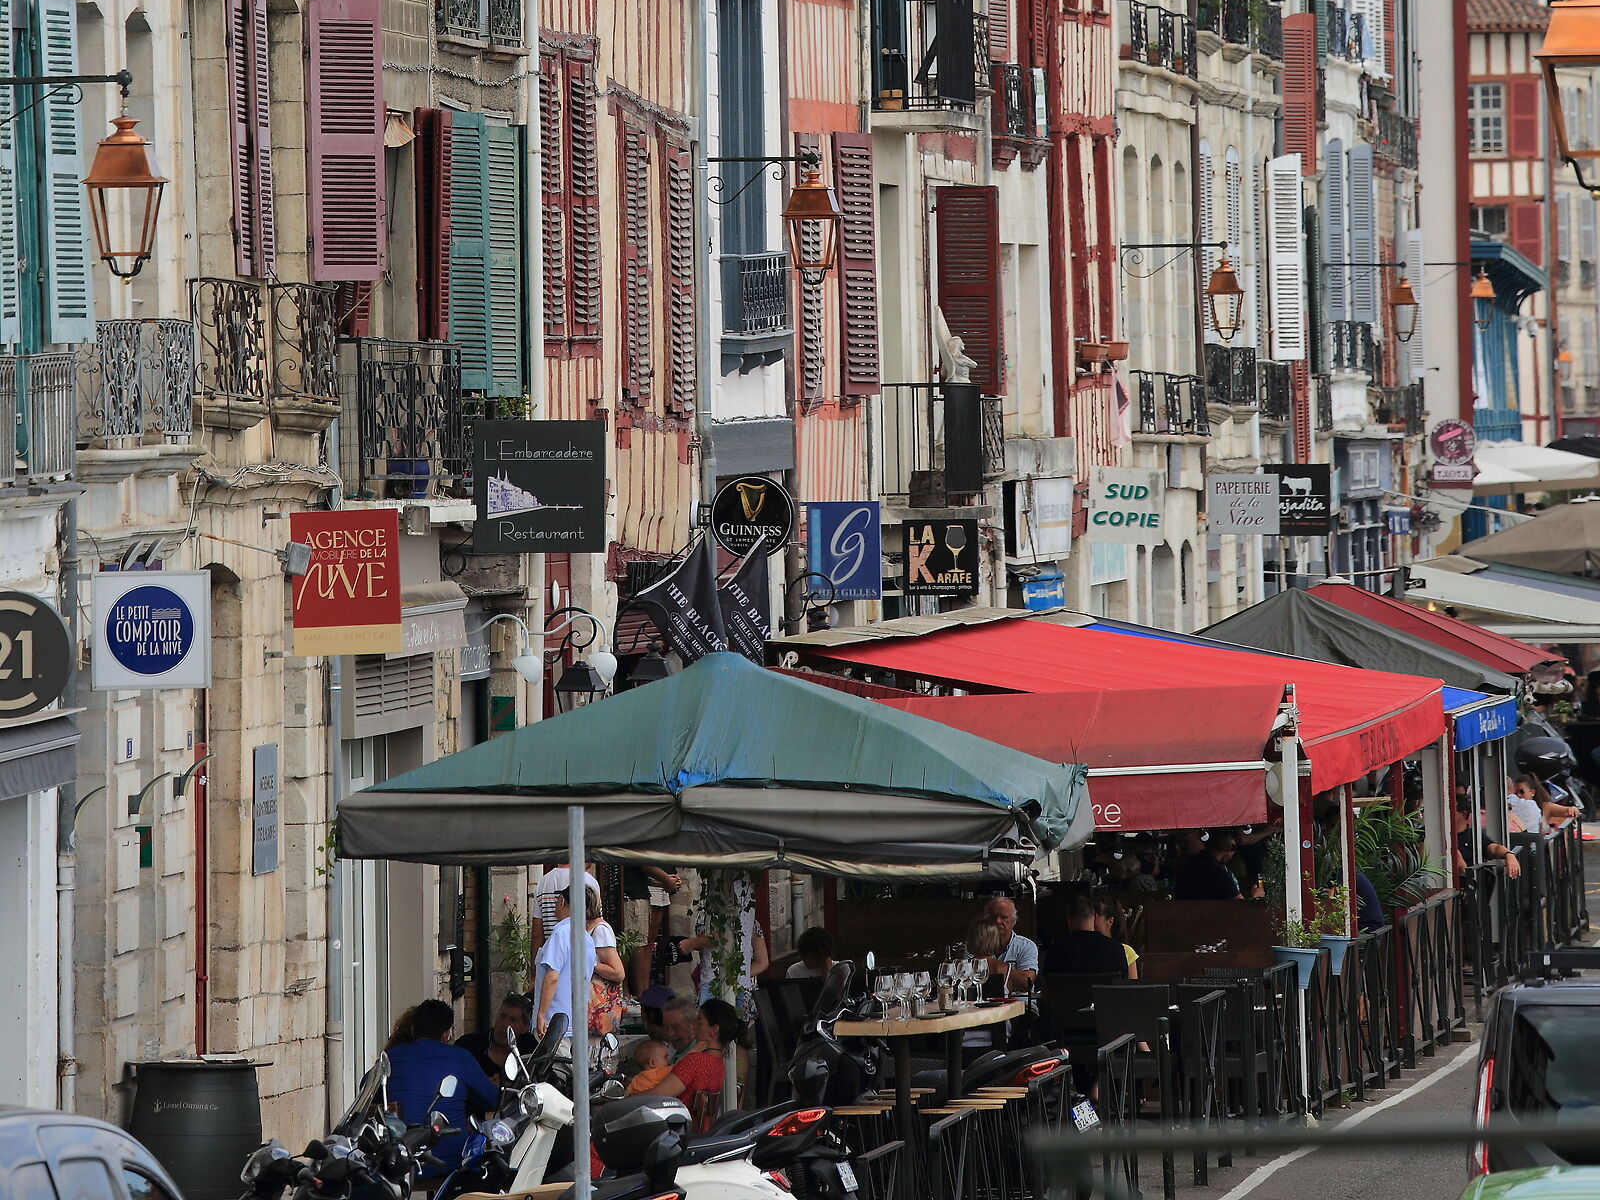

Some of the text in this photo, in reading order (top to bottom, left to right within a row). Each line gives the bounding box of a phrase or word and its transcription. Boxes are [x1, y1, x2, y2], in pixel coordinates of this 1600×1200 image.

[484, 440, 593, 460] L'Embarcadère
[1104, 483, 1149, 500] SUD
[1215, 482, 1271, 495] PAPETERIE
[1230, 497, 1260, 508] de la
[1092, 511, 1160, 528] COPIE
[1216, 510, 1265, 526] Nive
[499, 521, 585, 541] Restaurant
[719, 522, 782, 536] GUINNESS
[909, 525, 935, 545] LA
[304, 529, 388, 550] AGENCE
[360, 548, 372, 558] DE
[374, 548, 387, 558] LA
[667, 583, 688, 608] THE
[841, 588, 878, 597] GILLES
[116, 605, 149, 620] LE PETIT
[728, 583, 771, 640] THE BLAC
[115, 620, 182, 643] COMPTOIR
[673, 616, 693, 640] PUBLIC
[734, 614, 752, 639] PUBLIC
[137, 641, 182, 656] DE LA NIVE
